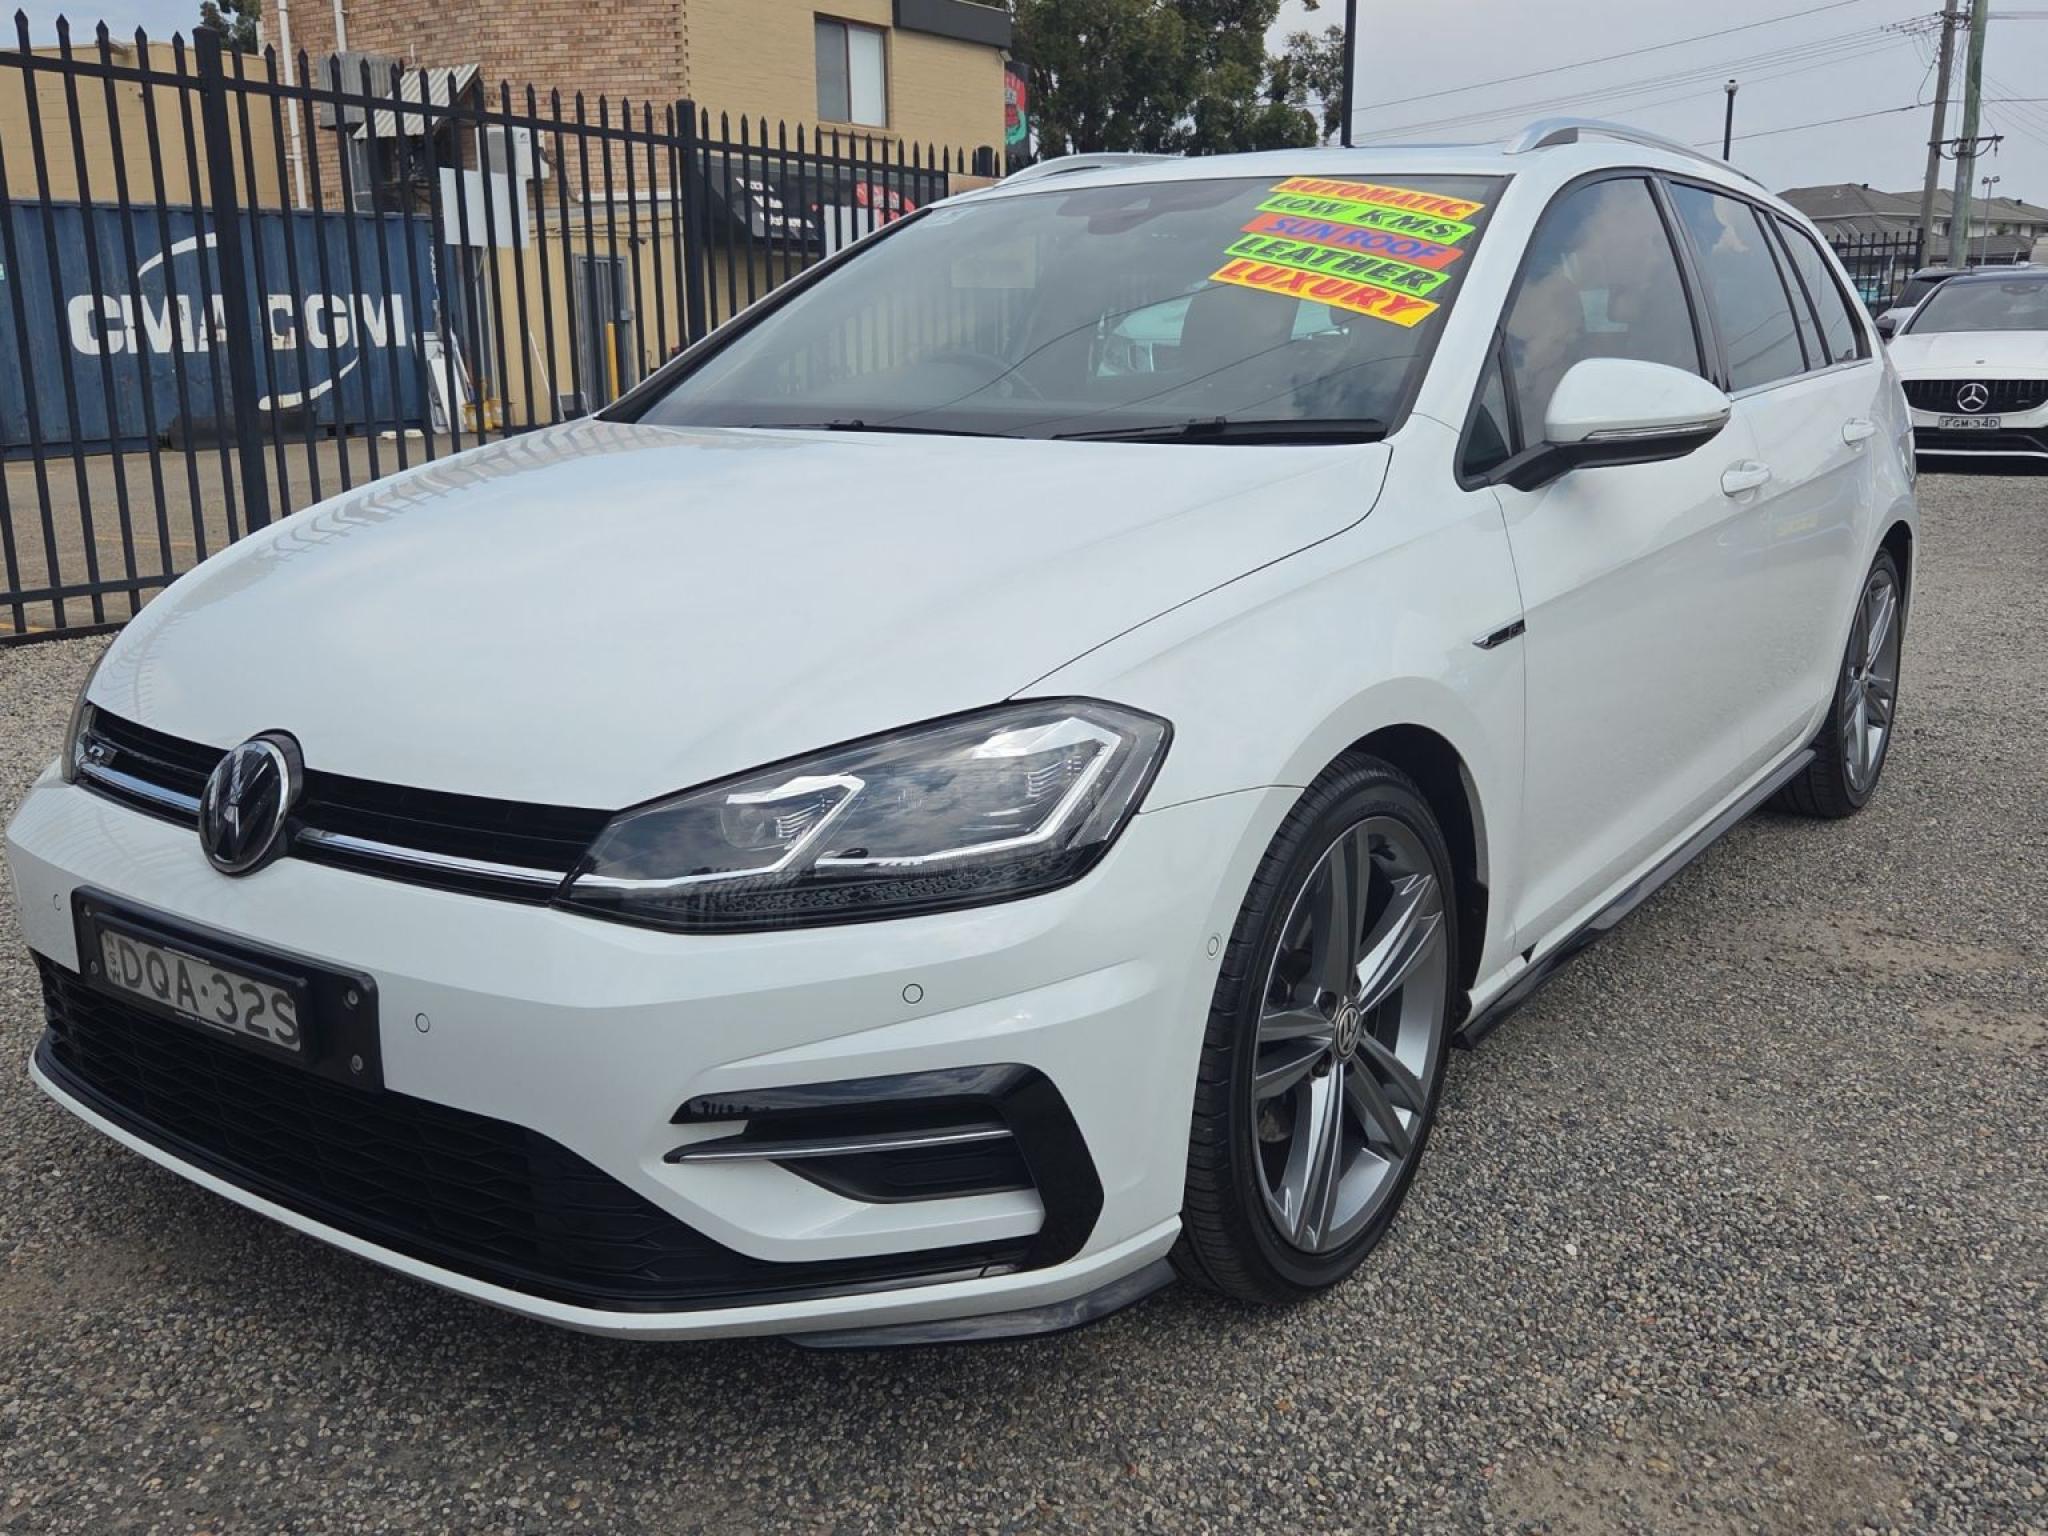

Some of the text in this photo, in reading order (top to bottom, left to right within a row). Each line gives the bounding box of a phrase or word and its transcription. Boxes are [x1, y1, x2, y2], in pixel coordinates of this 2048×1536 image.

[1267, 194, 1462, 238] LOW KMS
[1286, 179, 1473, 217] AUTOMATIC
[1218, 260, 1429, 317] LUXURY
[1229, 236, 1440, 290] LEATHER
[257, 293, 406, 350] CGM
